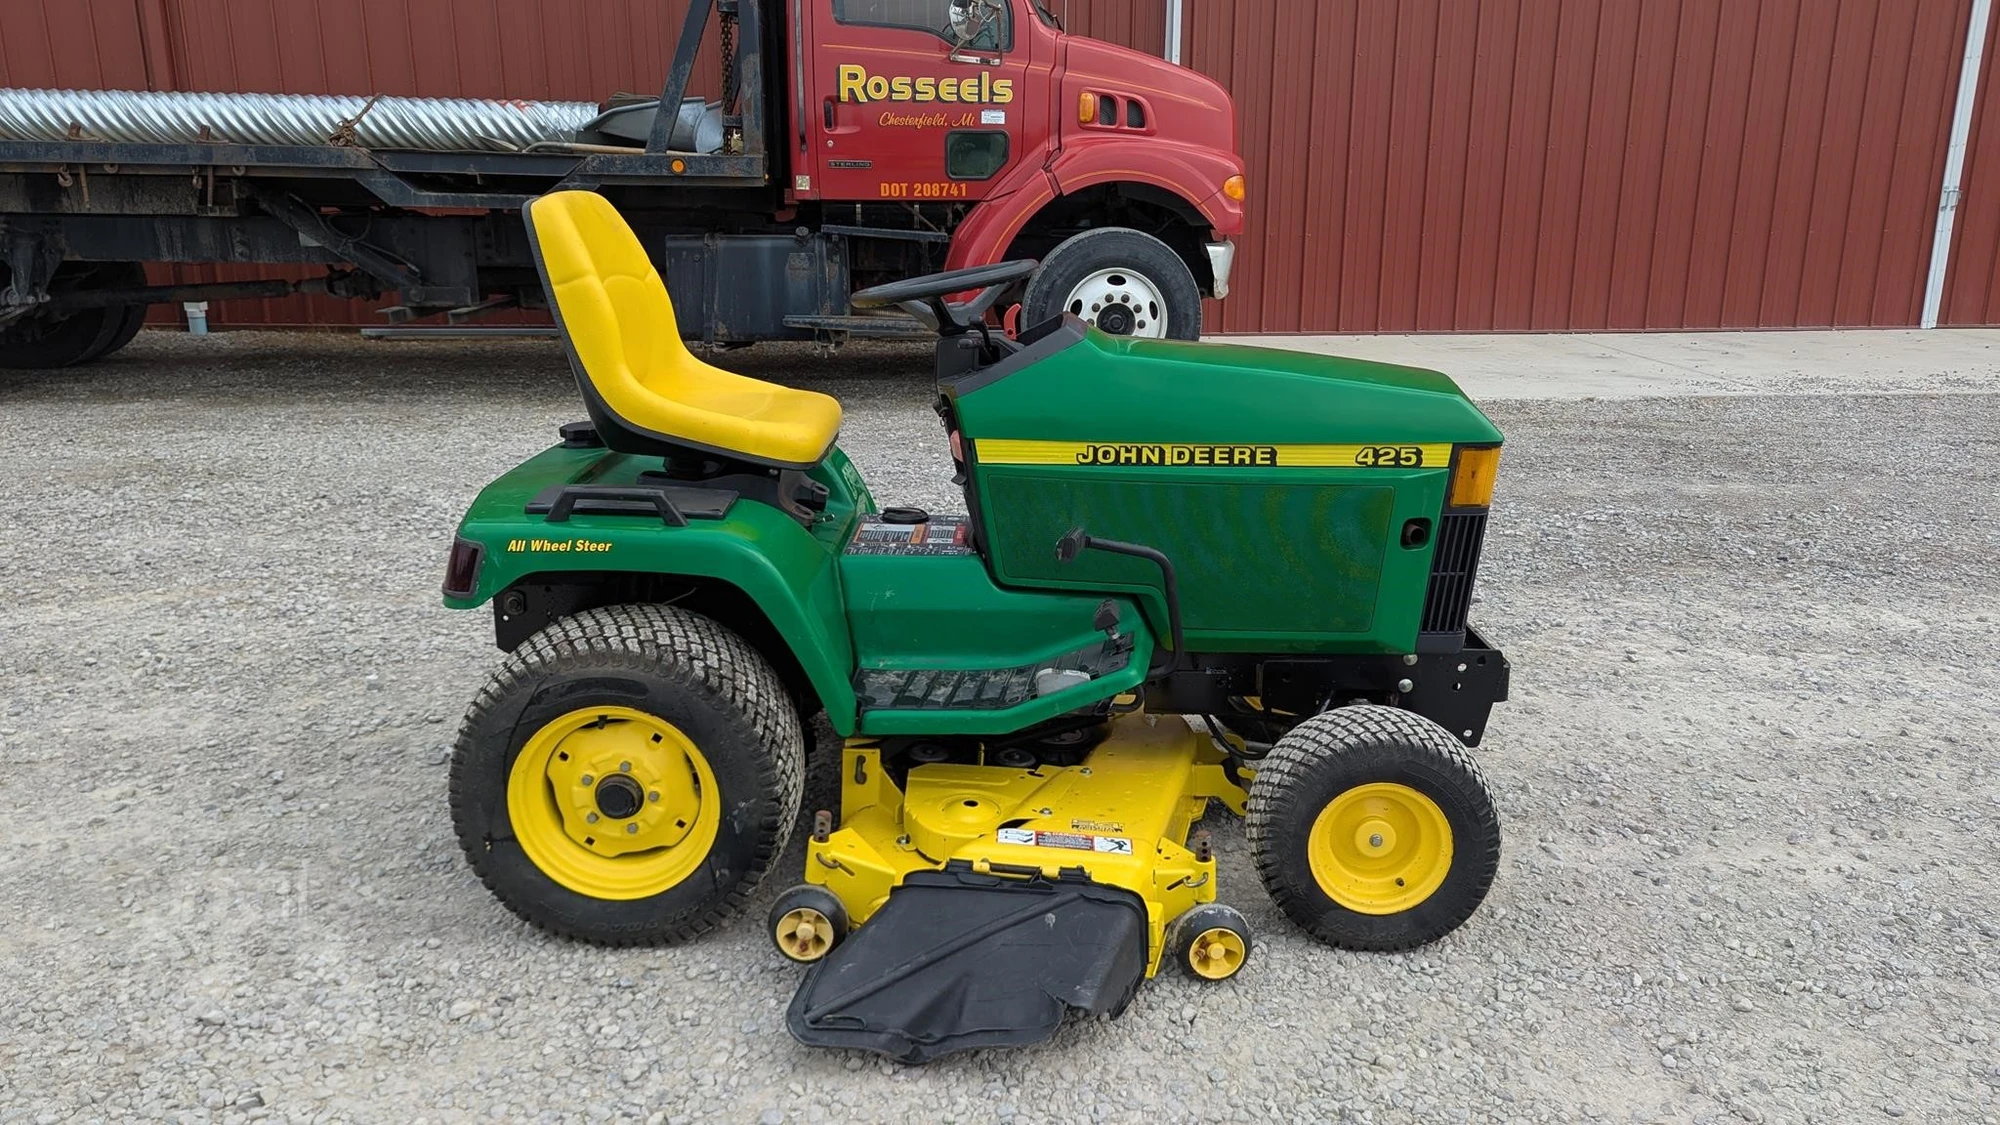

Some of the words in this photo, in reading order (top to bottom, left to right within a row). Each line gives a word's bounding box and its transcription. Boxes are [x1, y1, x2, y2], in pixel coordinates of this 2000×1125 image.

[837, 64, 1014, 104] Rosseels
[879, 111, 948, 129] Chesterfield,
[951, 114, 975, 127] Mi
[880, 183, 909, 197] DOT
[913, 183, 968, 197] 208741
[1075, 444, 1163, 466] JOHN
[1170, 444, 1277, 466] DEERE
[1355, 446, 1424, 466] 425
[507, 540, 526, 552] All
[530, 540, 573, 552] Wheel
[575, 540, 613, 552] Steer
